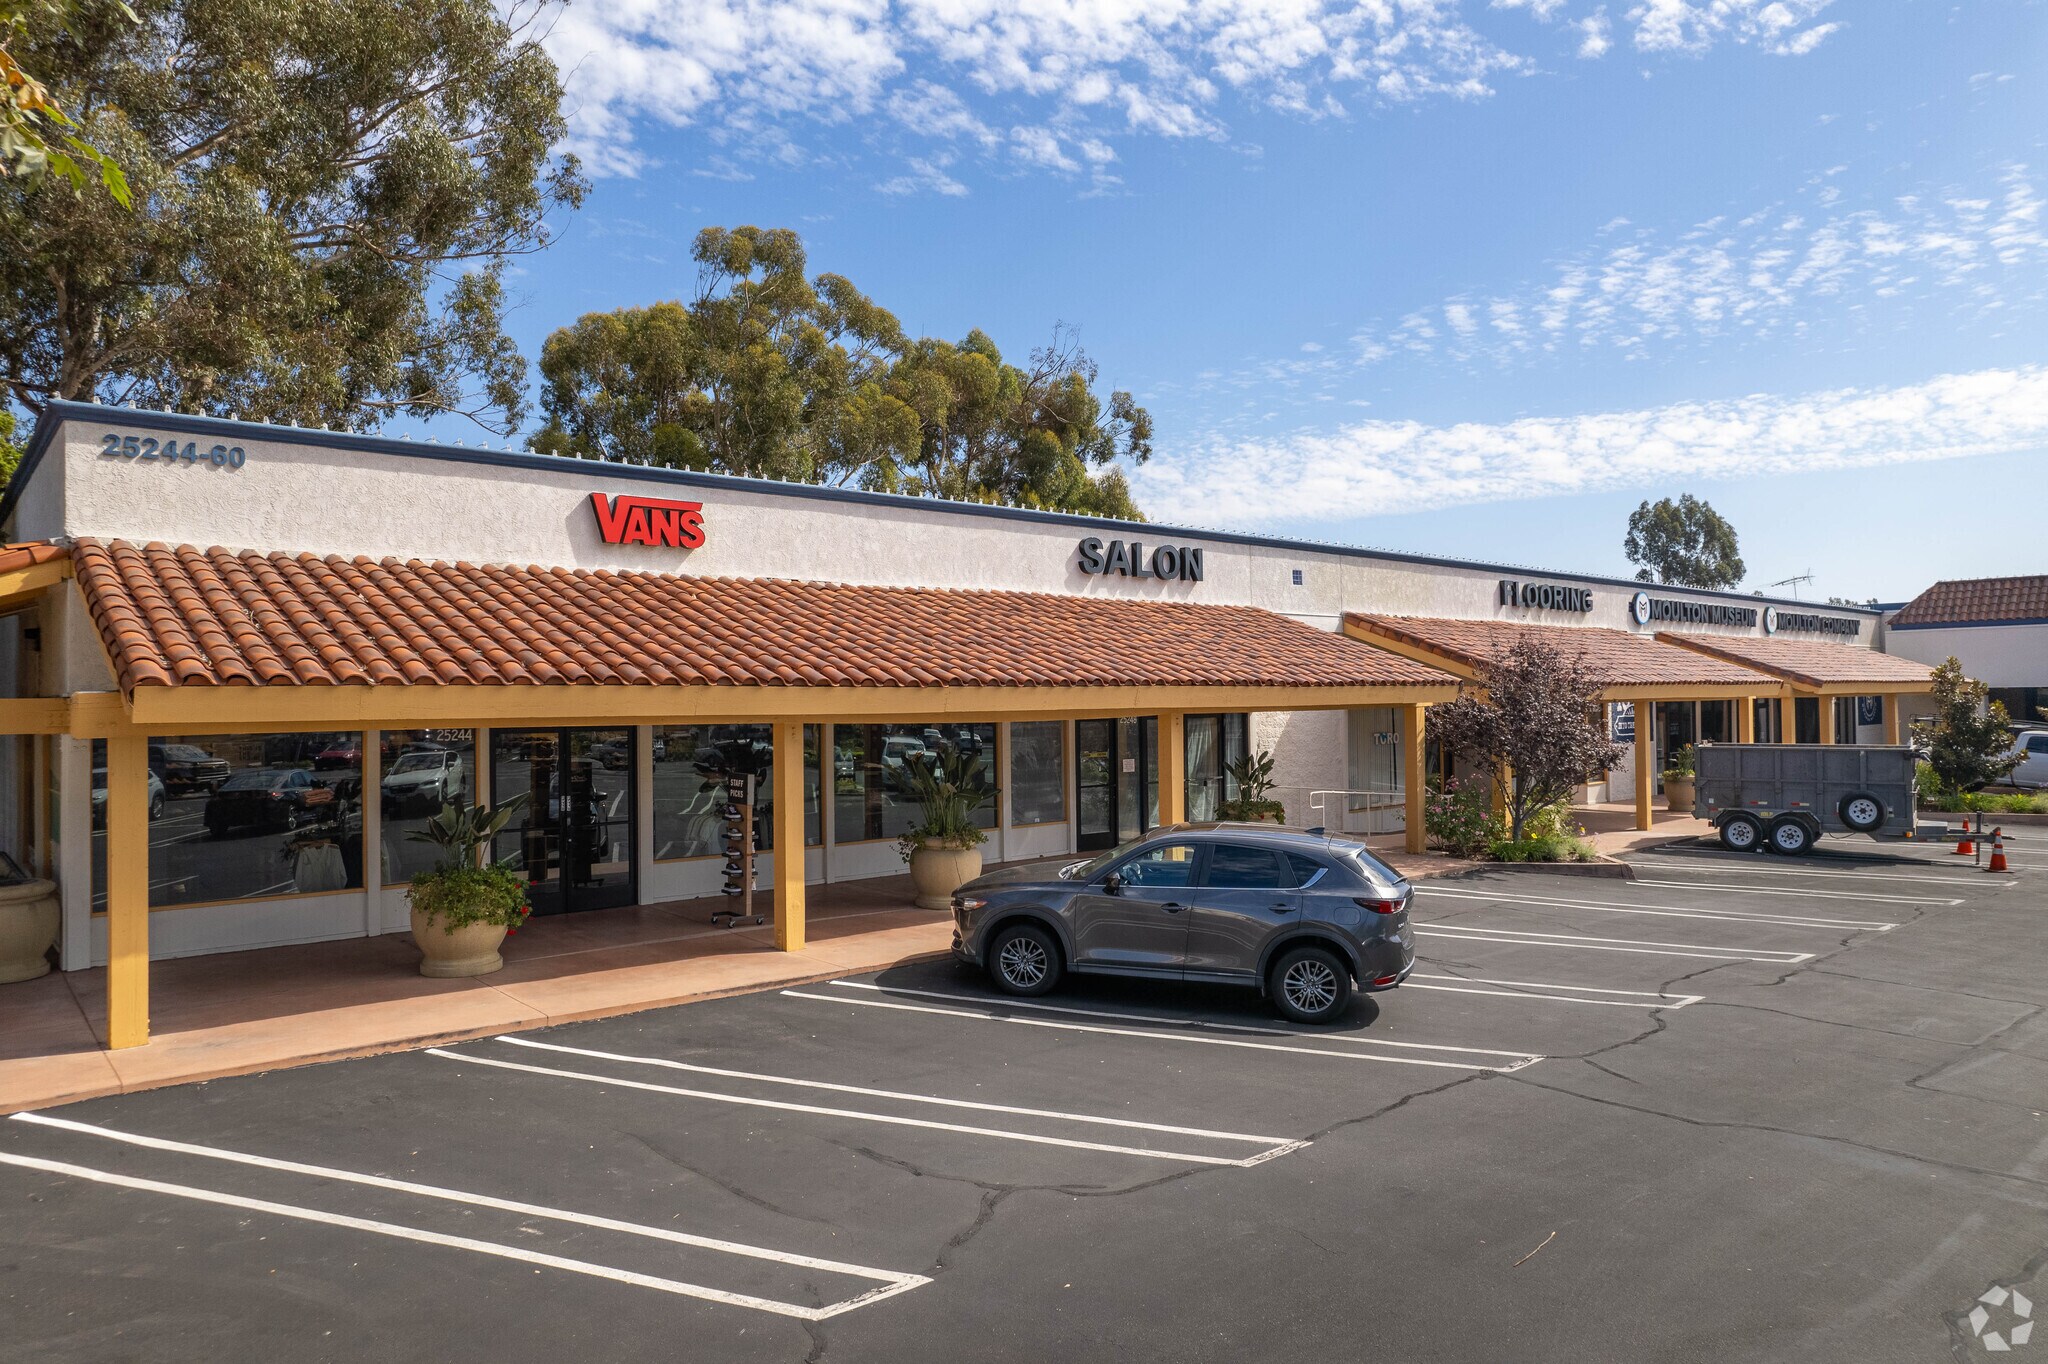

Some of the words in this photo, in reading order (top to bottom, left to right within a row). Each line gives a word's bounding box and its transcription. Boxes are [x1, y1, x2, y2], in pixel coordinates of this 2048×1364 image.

[102, 433, 247, 469] 25244-60
[589, 491, 706, 549] VANS
[1078, 536, 1204, 582] SALON
[1500, 580, 1594, 613] FLOORING
[1650, 599, 1709, 625] MOULTON
[1711, 605, 1757, 627] MUSEUM
[1777, 613, 1820, 633] MOULTON
[1821, 616, 1860, 635] COMPANY
[436, 728, 473, 742] 25244
[729, 789, 744, 799] PICKS
[730, 778, 744, 788] STAFF
